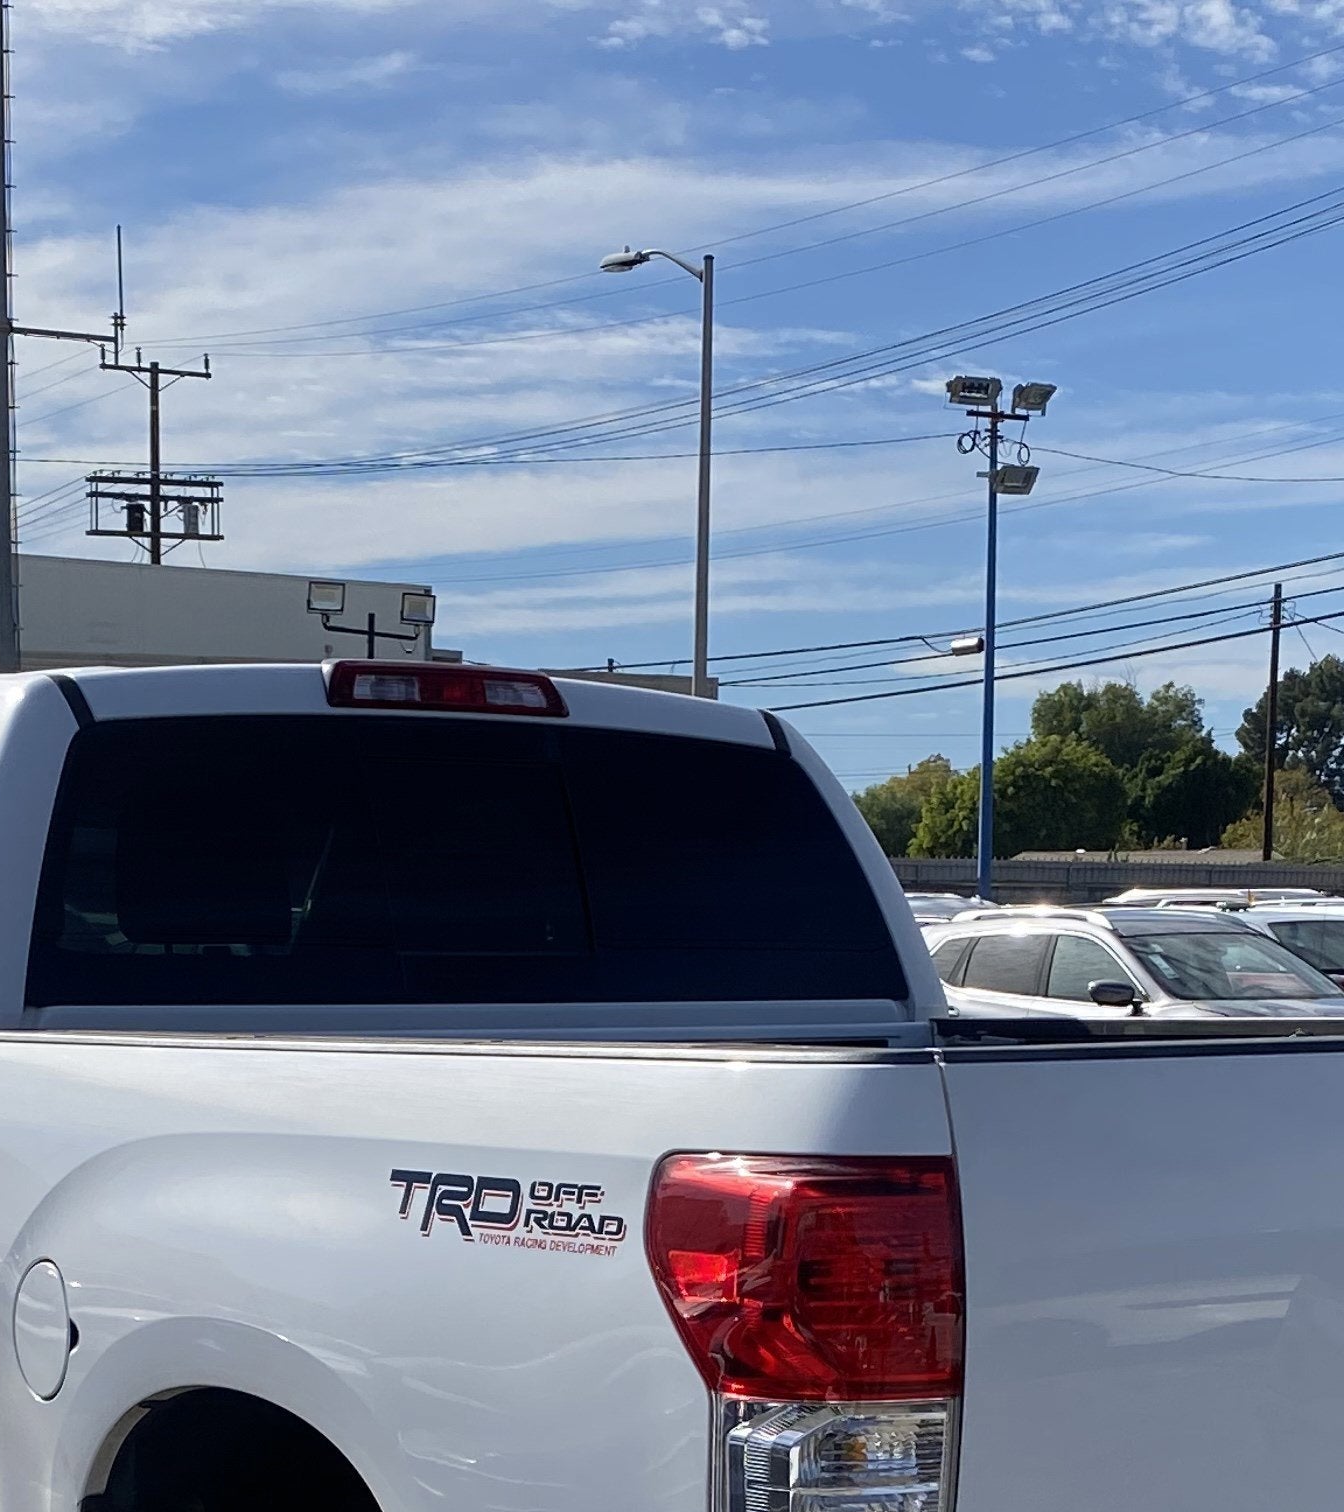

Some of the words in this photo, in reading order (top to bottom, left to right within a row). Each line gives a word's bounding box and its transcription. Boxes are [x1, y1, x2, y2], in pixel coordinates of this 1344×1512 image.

[389, 1168, 524, 1242] TRD
[529, 1180, 605, 1209] OFF
[523, 1208, 627, 1241] ROAD
[478, 1231, 512, 1246] TOYOTA
[513, 1236, 548, 1250] RACING
[549, 1239, 618, 1257] DEVELOPMENT
